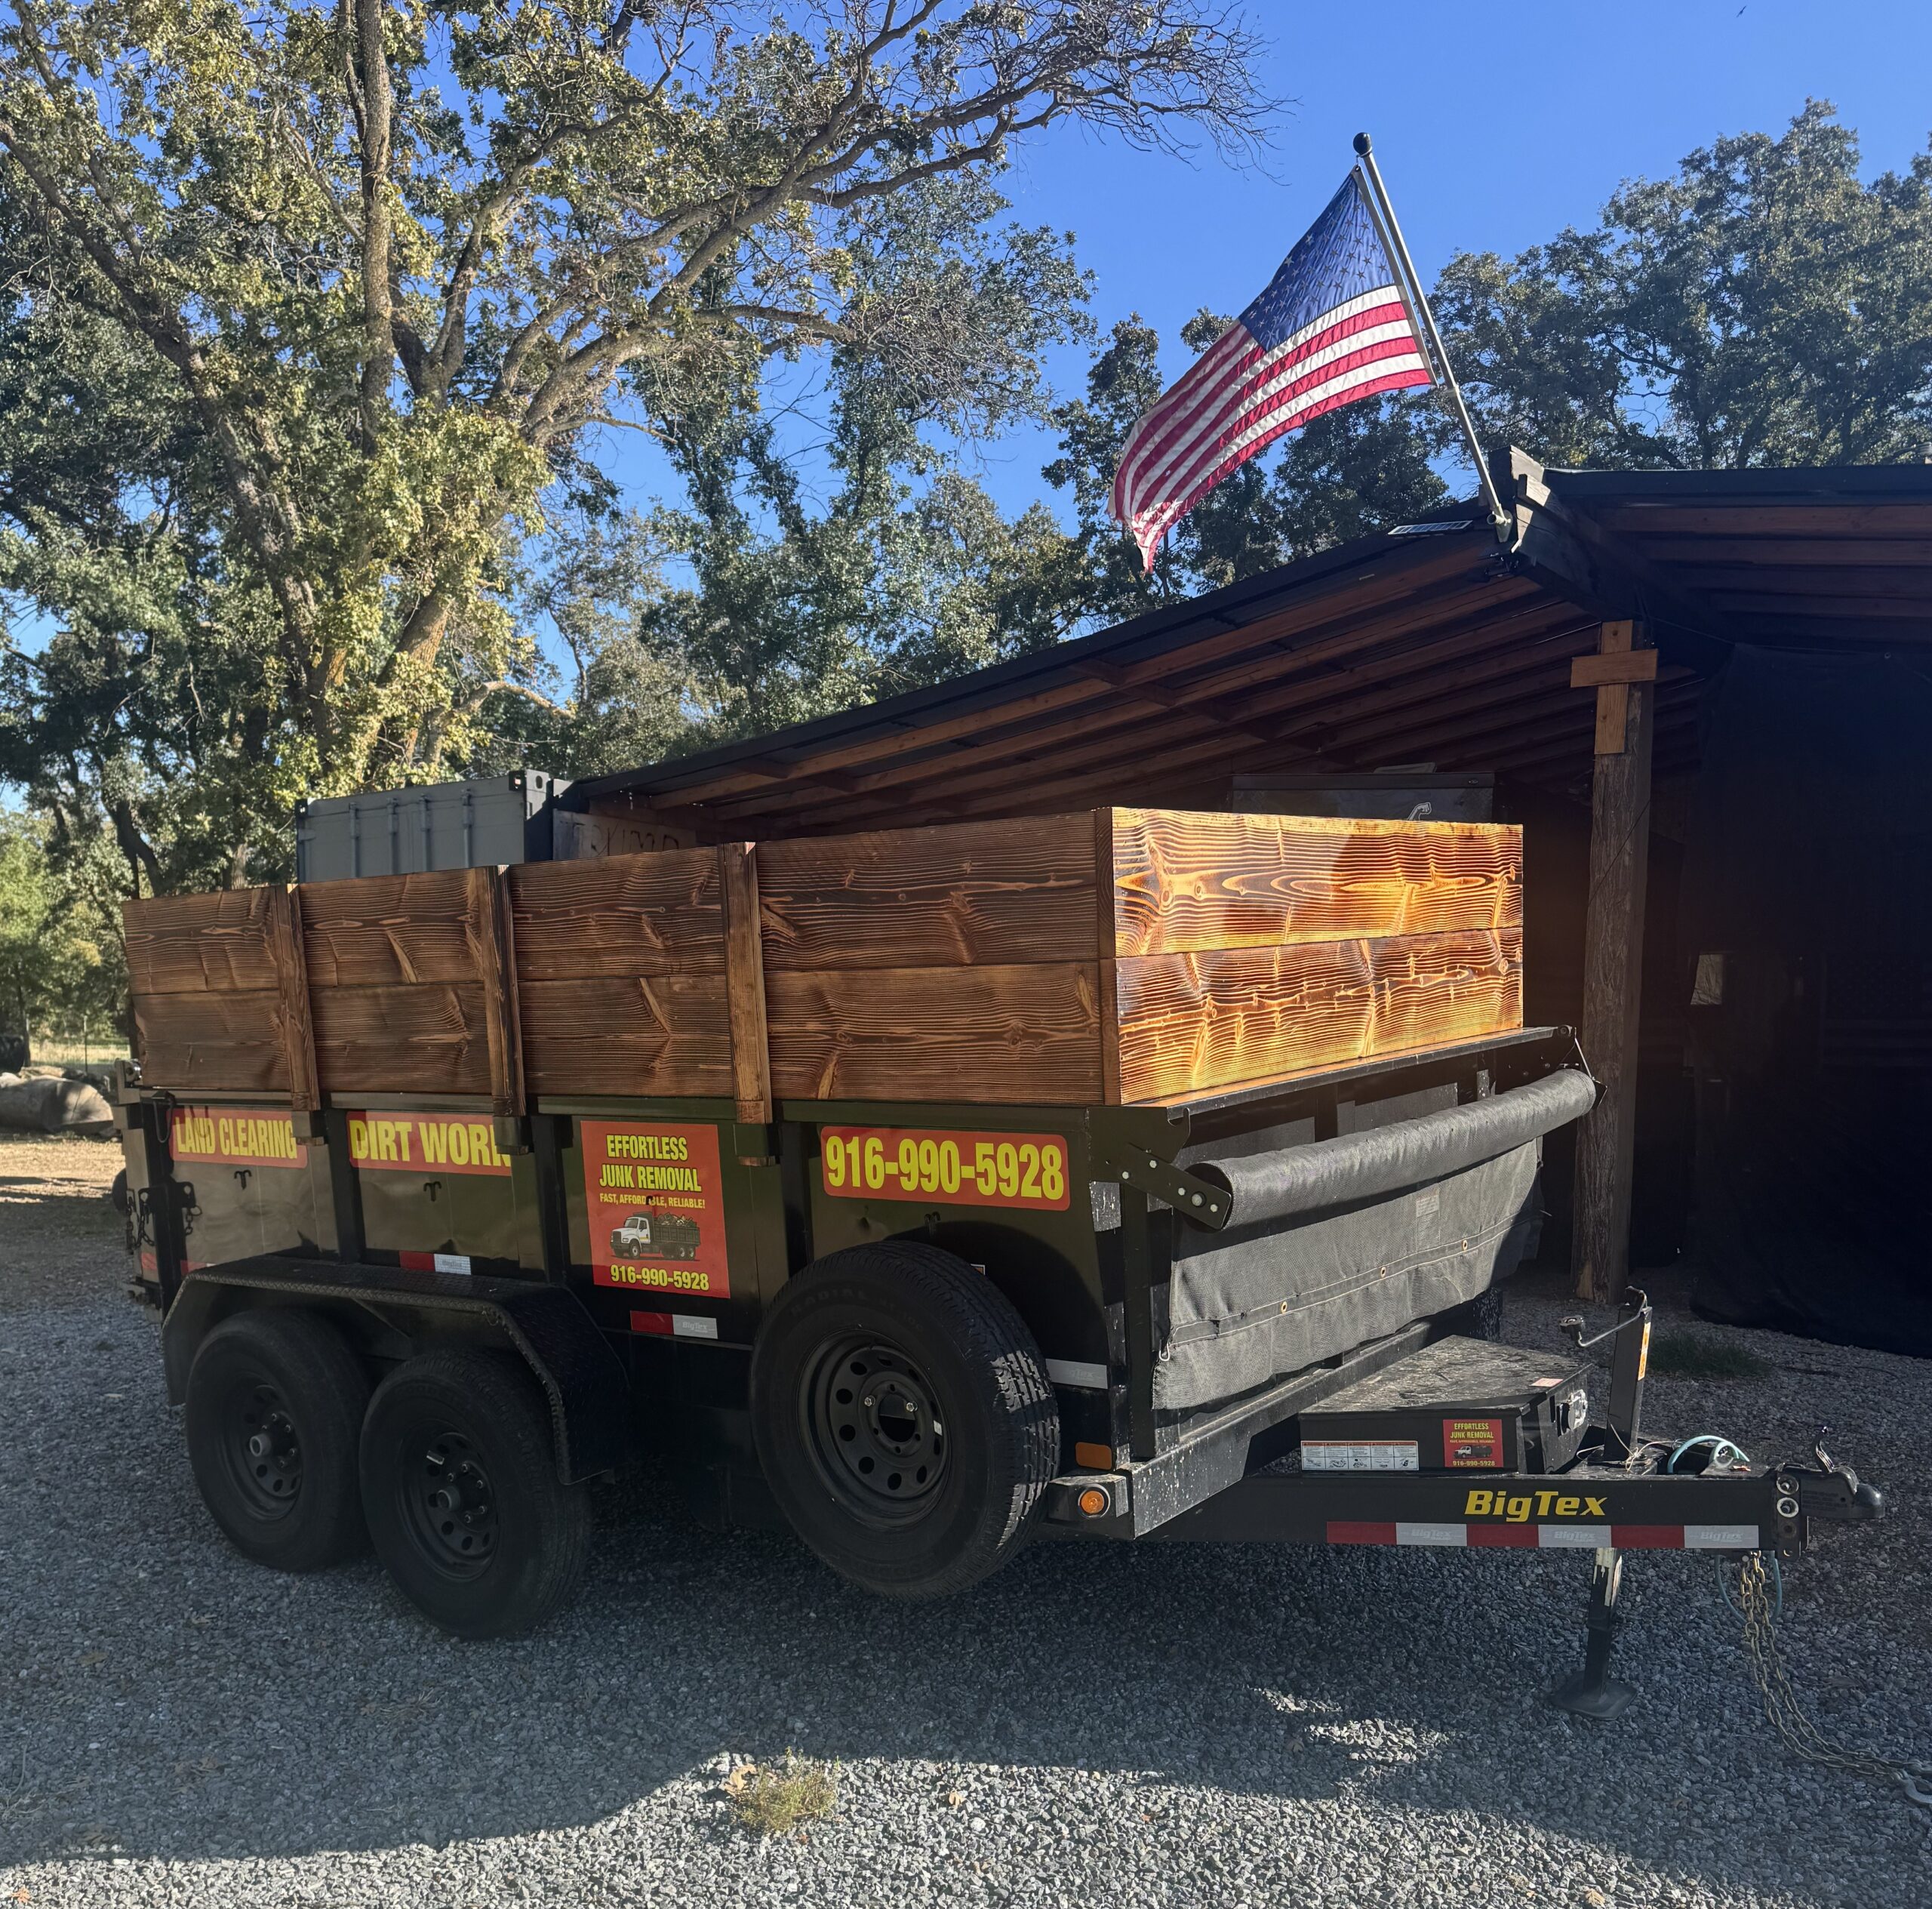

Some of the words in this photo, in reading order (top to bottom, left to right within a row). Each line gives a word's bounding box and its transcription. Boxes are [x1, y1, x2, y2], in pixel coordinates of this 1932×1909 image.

[174, 1116, 216, 1154] LAND
[219, 1117, 298, 1159] CLEARING
[349, 1119, 413, 1162] DIRT
[606, 1135, 688, 1161] EFFORTLESS
[599, 1163, 635, 1188] JUNK
[638, 1165, 702, 1192] REMOVAL
[826, 1135, 1064, 1201] 916-990-5928
[600, 1193, 618, 1205] FAST,
[620, 1194, 667, 1208] AFFORDBLE,
[668, 1196, 706, 1209] RELIABLE!
[611, 1264, 709, 1291] 916-990-5928
[1464, 1490, 1608, 1523] BigTex
